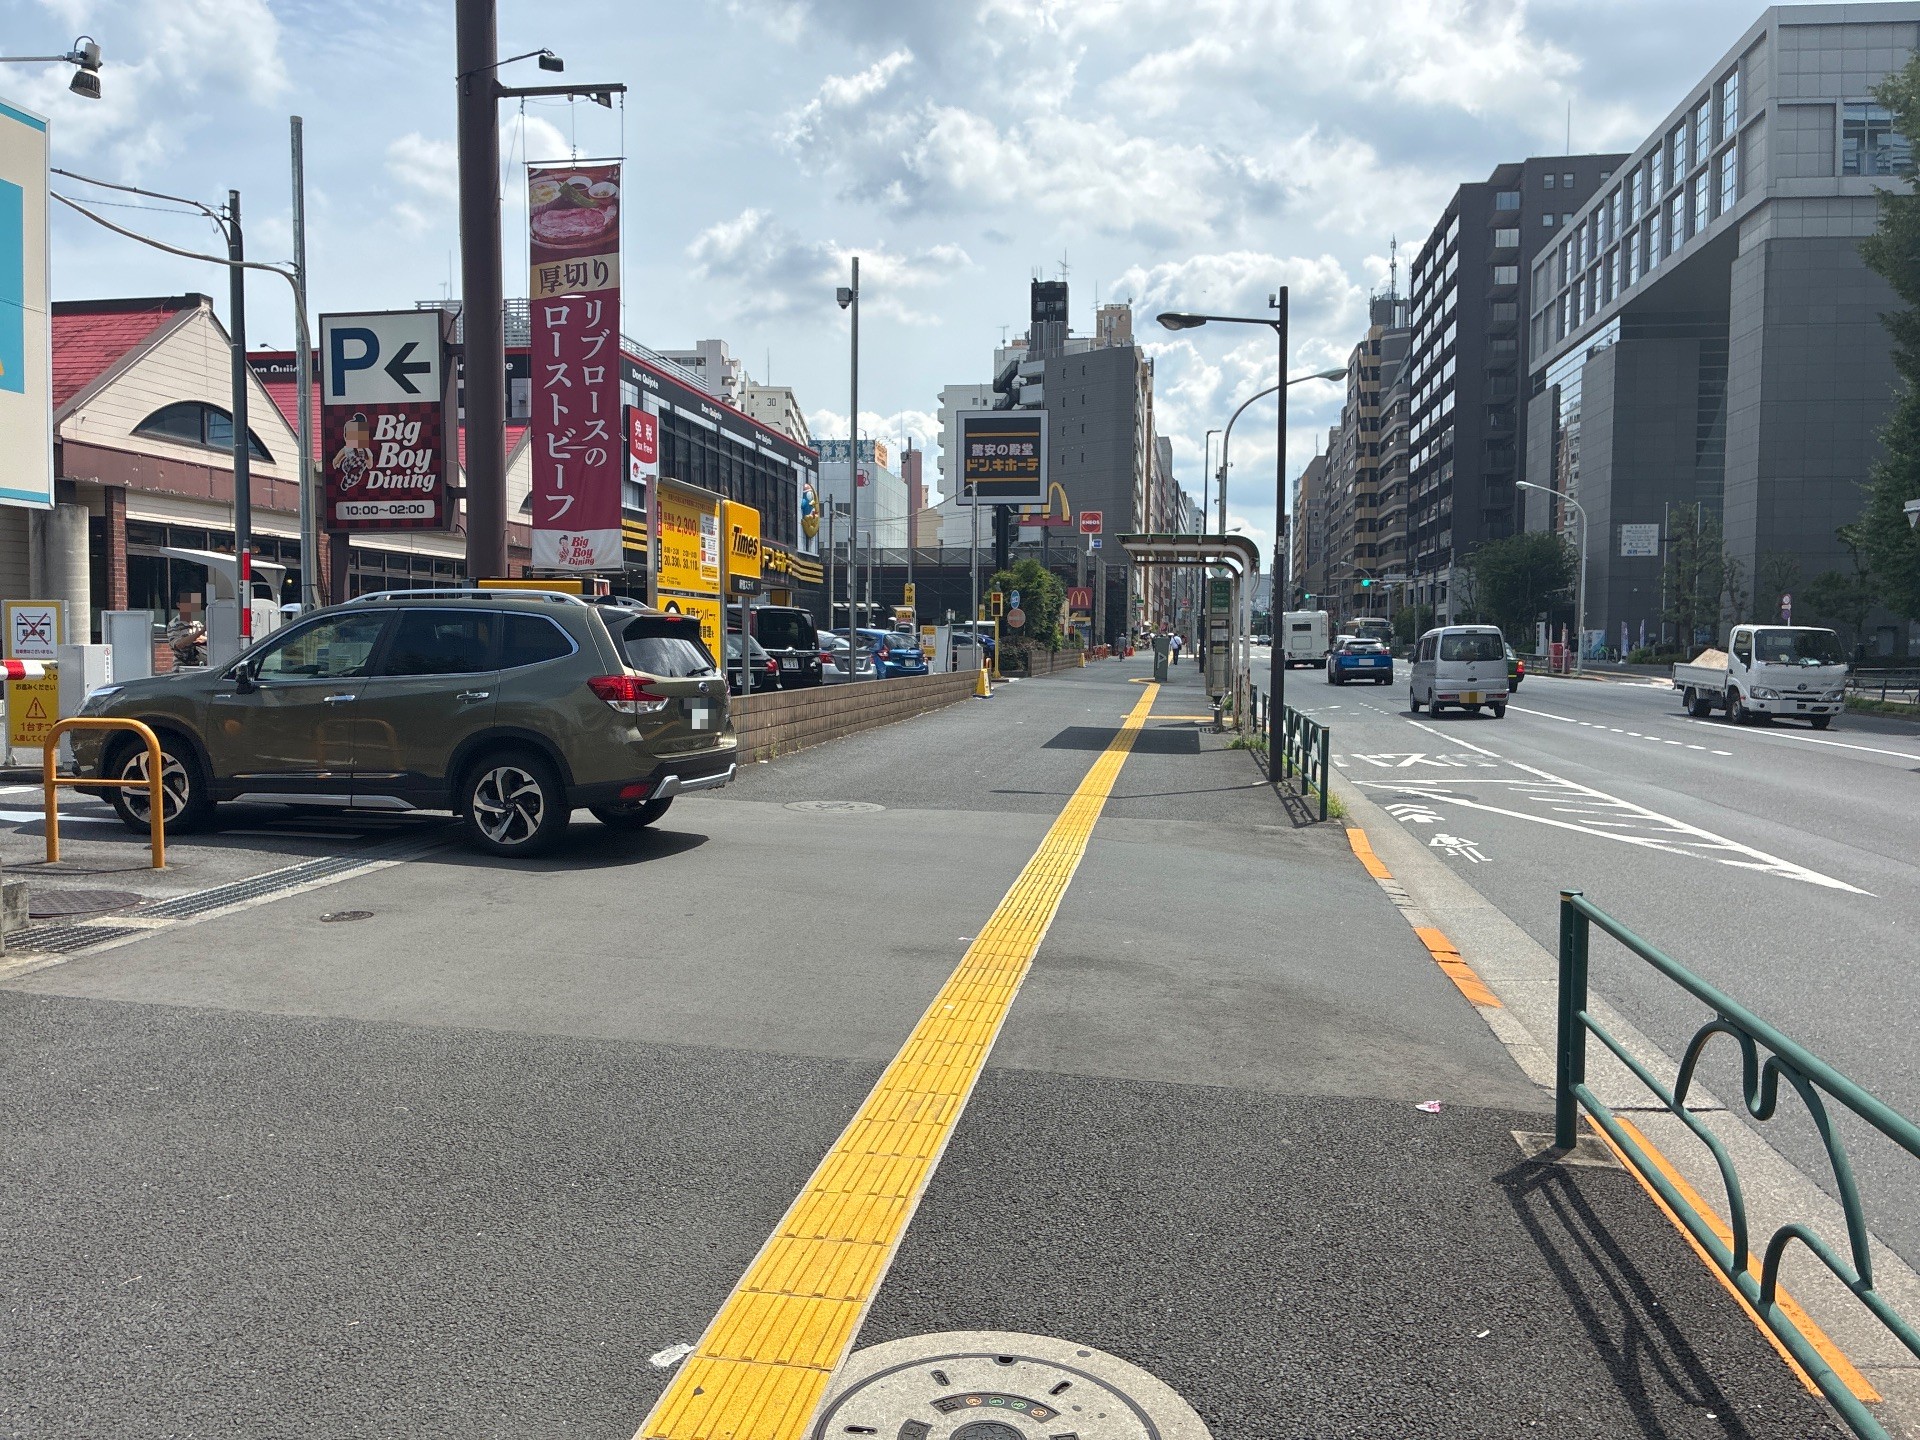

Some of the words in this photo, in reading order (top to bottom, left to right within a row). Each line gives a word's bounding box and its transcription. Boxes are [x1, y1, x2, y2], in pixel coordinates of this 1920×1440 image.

[539, 258, 609, 294] 厚切り
[330, 327, 380, 397] P
[581, 300, 610, 468] リブロースの
[632, 368, 642, 382] Don
[642, 373, 659, 389] Quijote
[543, 305, 576, 522] ローストビーフ
[767, 397, 777, 407] 30
[373, 413, 422, 446] Big
[376, 442, 432, 474] Boy
[971, 443, 1034, 456] 驚安の殿堂
[366, 470, 436, 493] Dining
[571, 536, 589, 548] Big
[572, 547, 593, 559] Boy
[733, 525, 758, 557] Times
[567, 557, 595, 566] Dining
